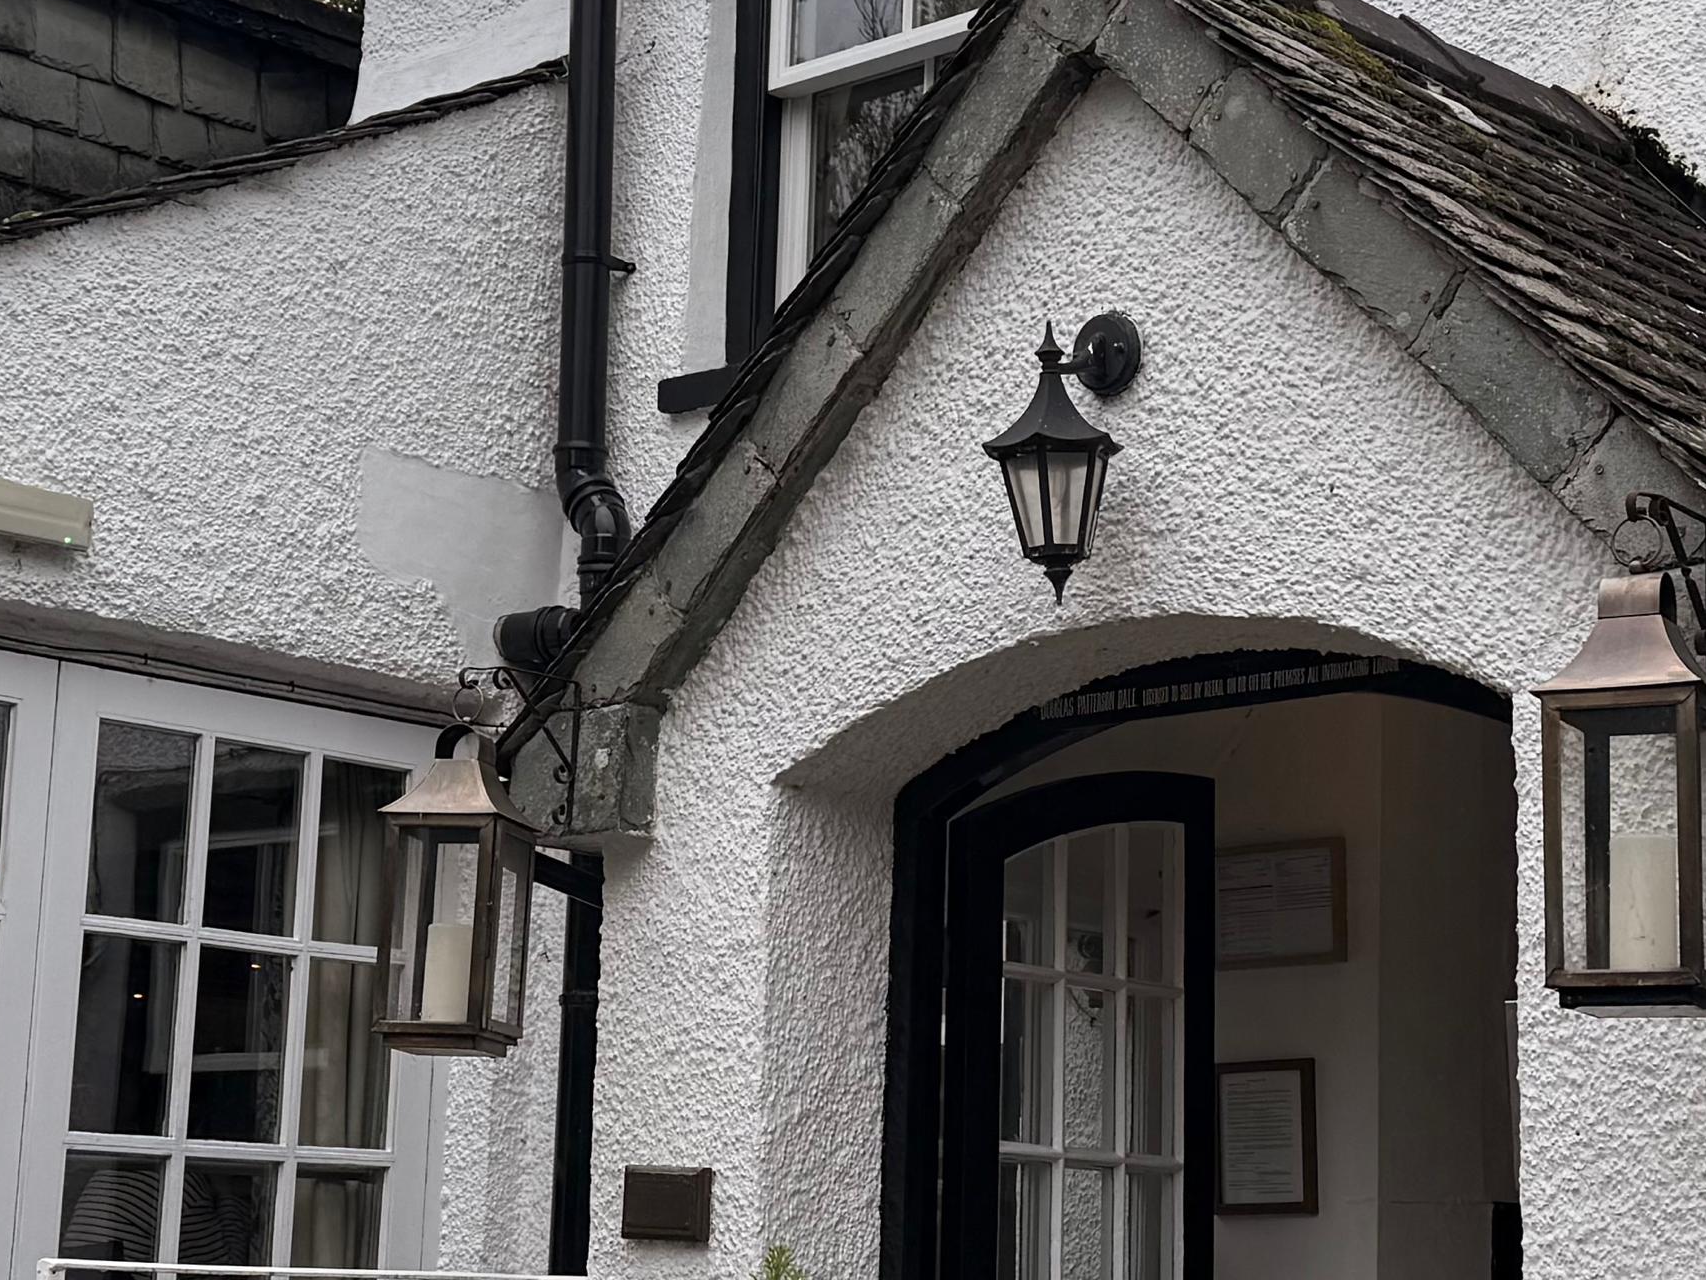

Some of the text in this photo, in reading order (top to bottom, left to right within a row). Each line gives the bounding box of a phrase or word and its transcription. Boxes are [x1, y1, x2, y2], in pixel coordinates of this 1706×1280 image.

[1040, 696, 1074, 721] DOUGLAS
[1077, 690, 1116, 715] PATTERSON
[1180, 682, 1193, 701] SELL
[1194, 681, 1204, 699] BY
[1204, 678, 1225, 698] RETAIL
[1260, 671, 1272, 690] THE
[1273, 667, 1306, 688] PREMISES
[1307, 665, 1319, 684] ALL
